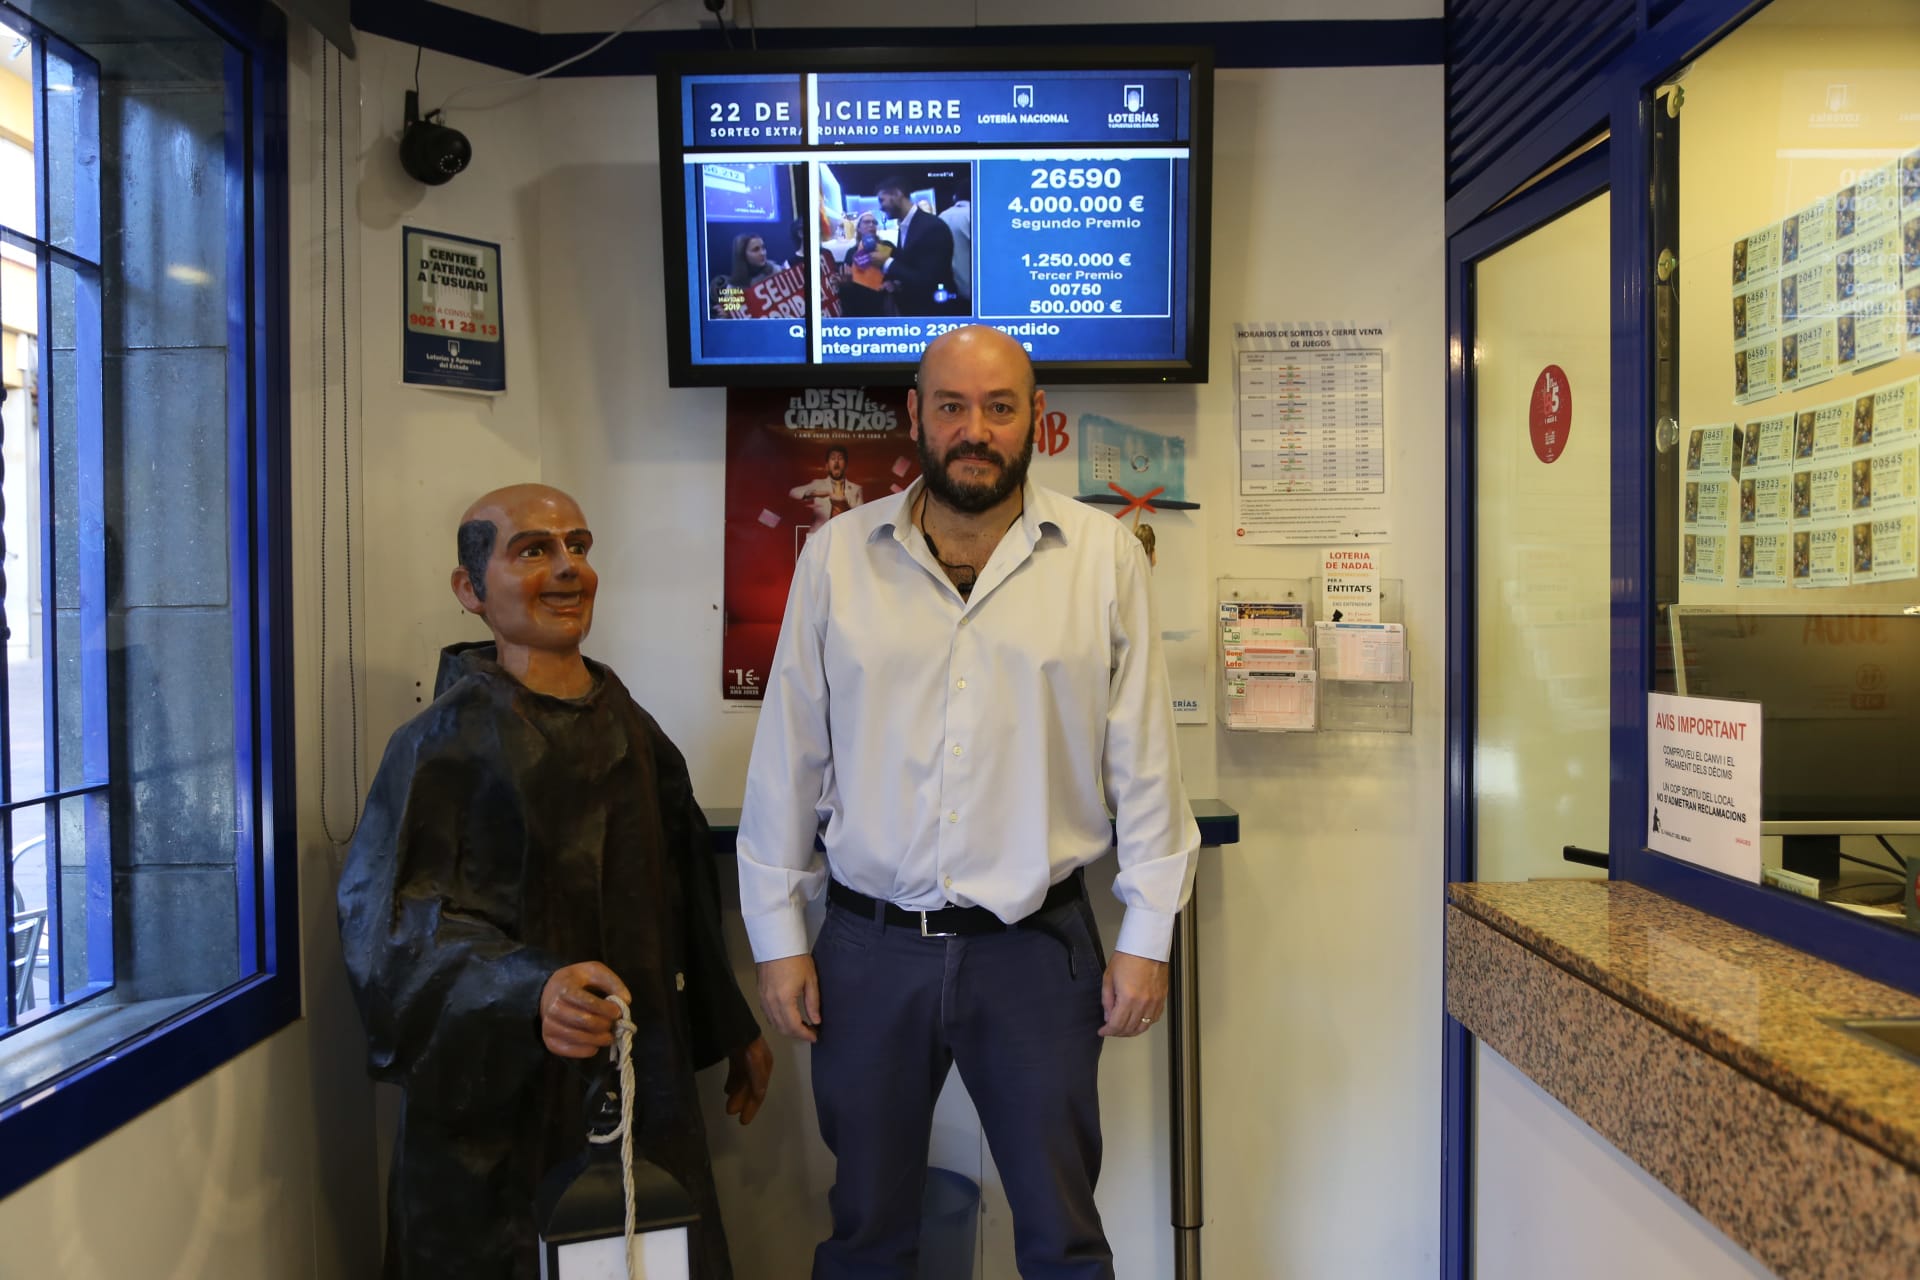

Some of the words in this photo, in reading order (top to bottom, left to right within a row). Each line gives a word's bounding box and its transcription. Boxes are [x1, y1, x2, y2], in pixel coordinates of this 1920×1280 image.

[710, 103, 741, 122] 22
[756, 102, 790, 121] DE
[818, 99, 961, 120] ICIEMBRE
[977, 112, 1017, 124] LOTERÍA
[1019, 113, 1069, 123] NACIONAL
[1108, 111, 1159, 123] LOTERÍAS
[710, 127, 760, 137] SORTEO
[884, 124, 900, 135] DE
[905, 124, 962, 135] NAVIDAD
[1030, 167, 1122, 189] 26590
[1008, 195, 1122, 213] 4.000.000
[1129, 195, 1145, 213] €
[1011, 218, 1081, 231] Segundo
[1086, 216, 1141, 228] Premio
[429, 248, 477, 267] CENTRE
[1022, 253, 1113, 267] 1.250.000
[1118, 252, 1132, 266] €
[420, 259, 486, 280] D'ATENCIÓ
[1029, 270, 1071, 280] Tercer
[1075, 270, 1123, 280] Premio
[417, 271, 427, 282] A
[431, 274, 488, 293] L'USUARI
[1050, 283, 1101, 295] 00750
[724, 303, 741, 311] 2019
[1030, 300, 1104, 313] 500.000
[1109, 300, 1122, 313] €
[410, 313, 435, 328] 902
[440, 318, 455, 330] 11
[459, 321, 477, 333] 23
[481, 324, 497, 336] 13
[789, 324, 851, 339] Qnto
[857, 323, 922, 340] premio
[985, 322, 1060, 336] endido
[1238, 330, 1277, 338] HORARIOS
[1279, 330, 1288, 338] DE
[1290, 329, 1324, 337] SORTEOS
[1359, 328, 1383, 336] VENTA
[1329, 552, 1370, 560] LOTERIA
[1341, 562, 1374, 570] NADAL
[1327, 585, 1372, 593] ENTITATS
[1656, 712, 1675, 732] AVIS
[1678, 715, 1747, 741] IMPORTANT
[1663, 745, 1695, 760] COMPROVEU
[1695, 751, 1703, 762] EL
[1704, 752, 1722, 765] CANVI
[1727, 756, 1735, 767] EL
[1664, 758, 1692, 772] PAGAMENT
[1692, 763, 1707, 775] DELS
[1662, 782, 1669, 792] UN
[1670, 783, 1681, 794] COP
[1681, 787, 1701, 800] SORTIU
[1702, 791, 1713, 803] DEL
[1714, 794, 1735, 807] LOCAL
[1656, 792, 1664, 802] NO
[1664, 795, 1697, 811] S'ADMETRAN
[1697, 803, 1746, 823] RECLAMACIONS
